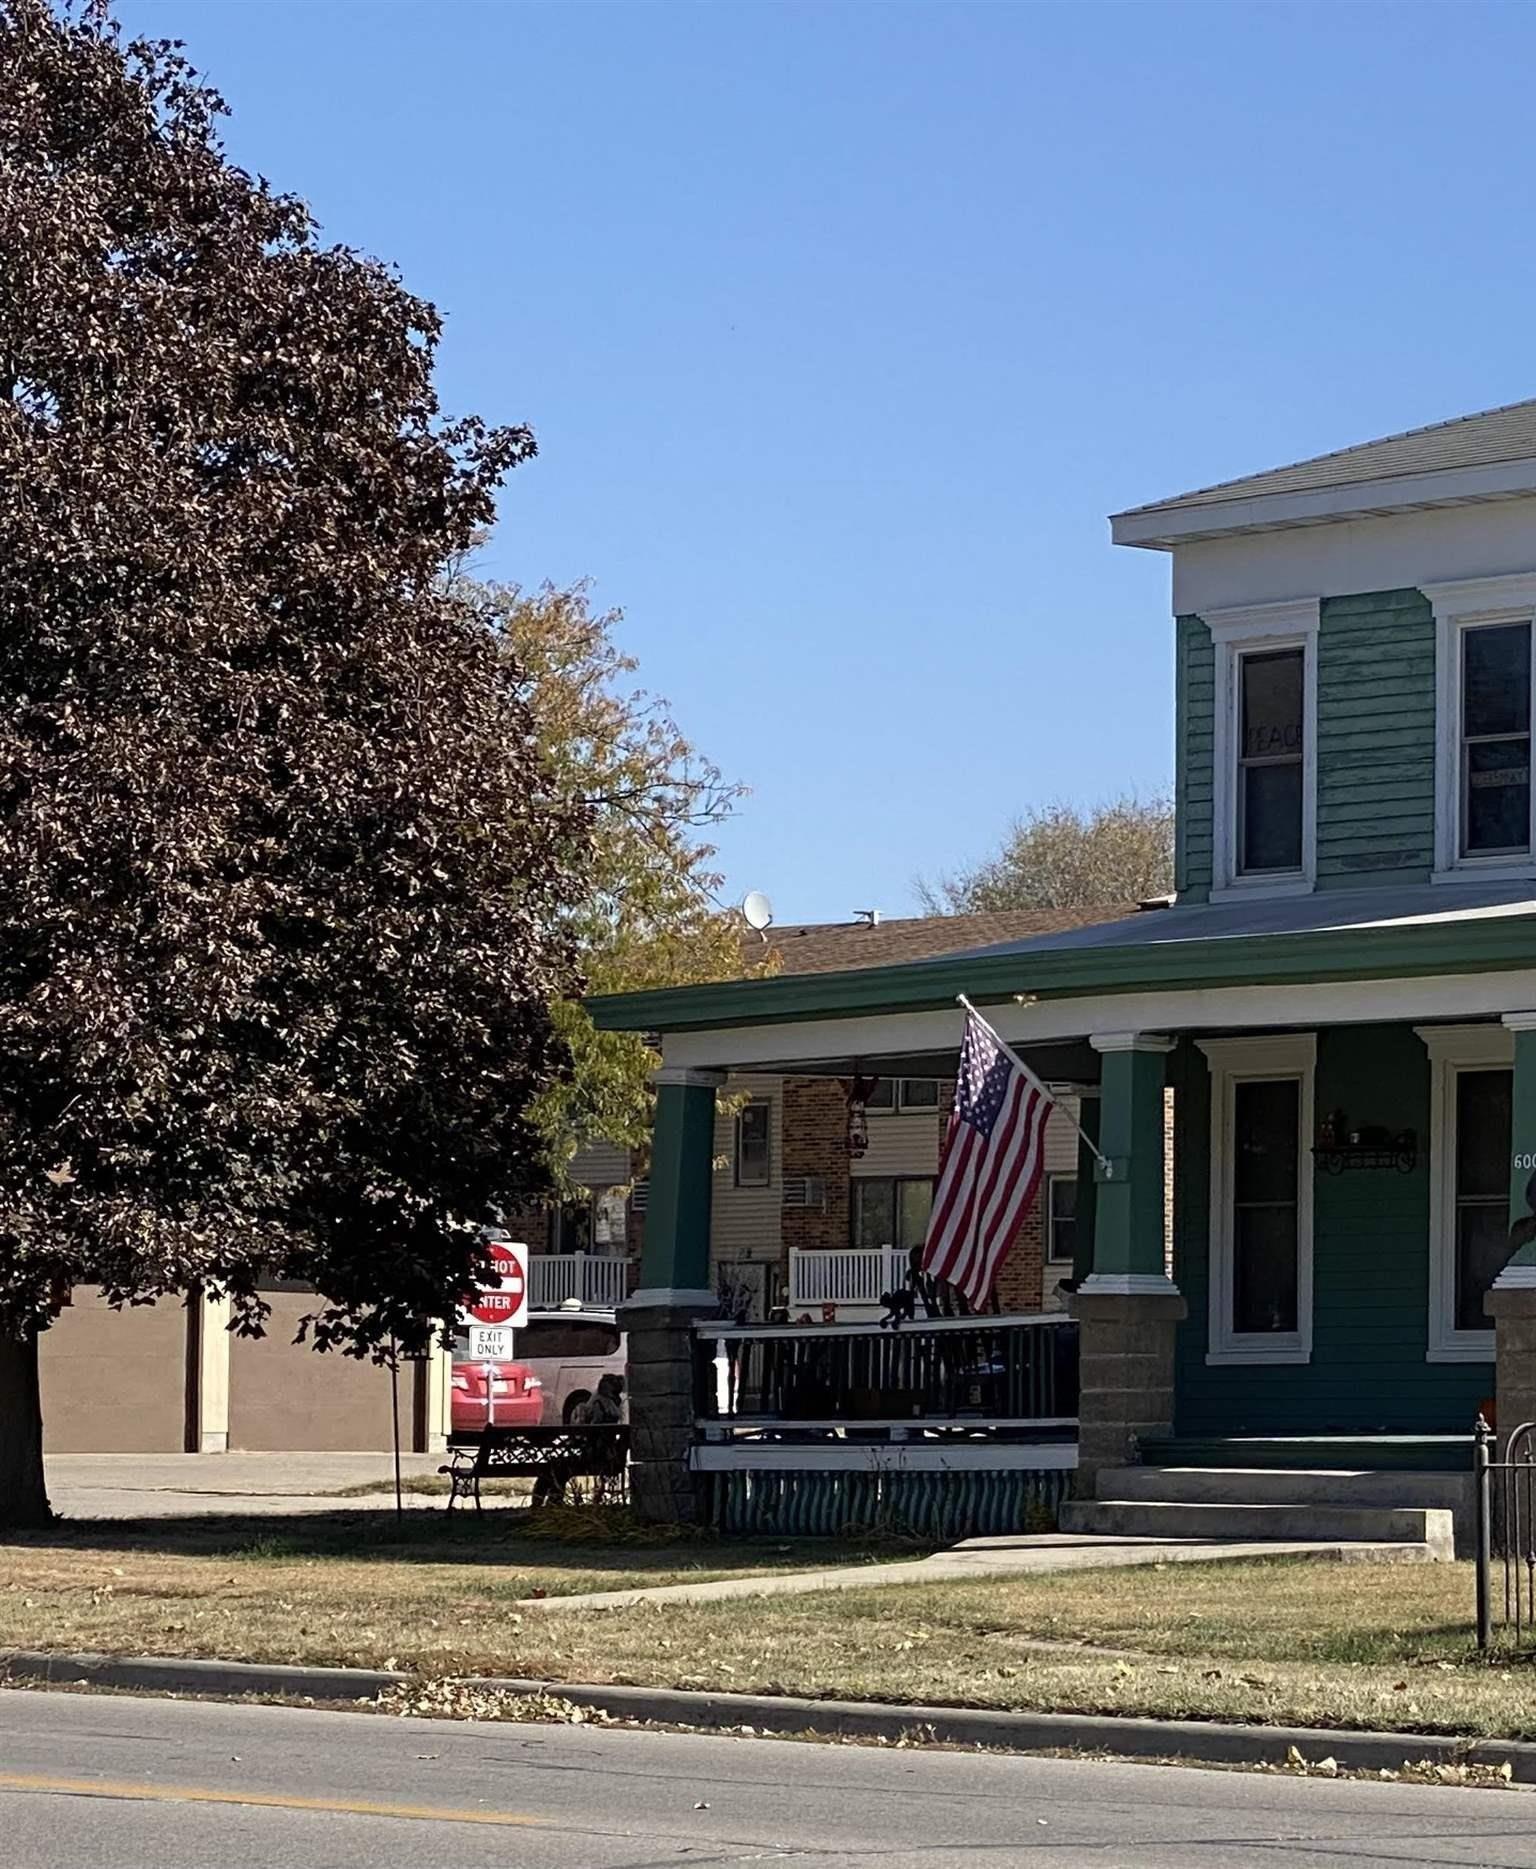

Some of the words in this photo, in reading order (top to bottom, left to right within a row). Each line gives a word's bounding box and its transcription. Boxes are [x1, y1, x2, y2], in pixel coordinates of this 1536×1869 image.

[471, 1295, 512, 1310] NTER
[479, 1331, 503, 1343] EXIT
[477, 1344, 505, 1356] ONLY
